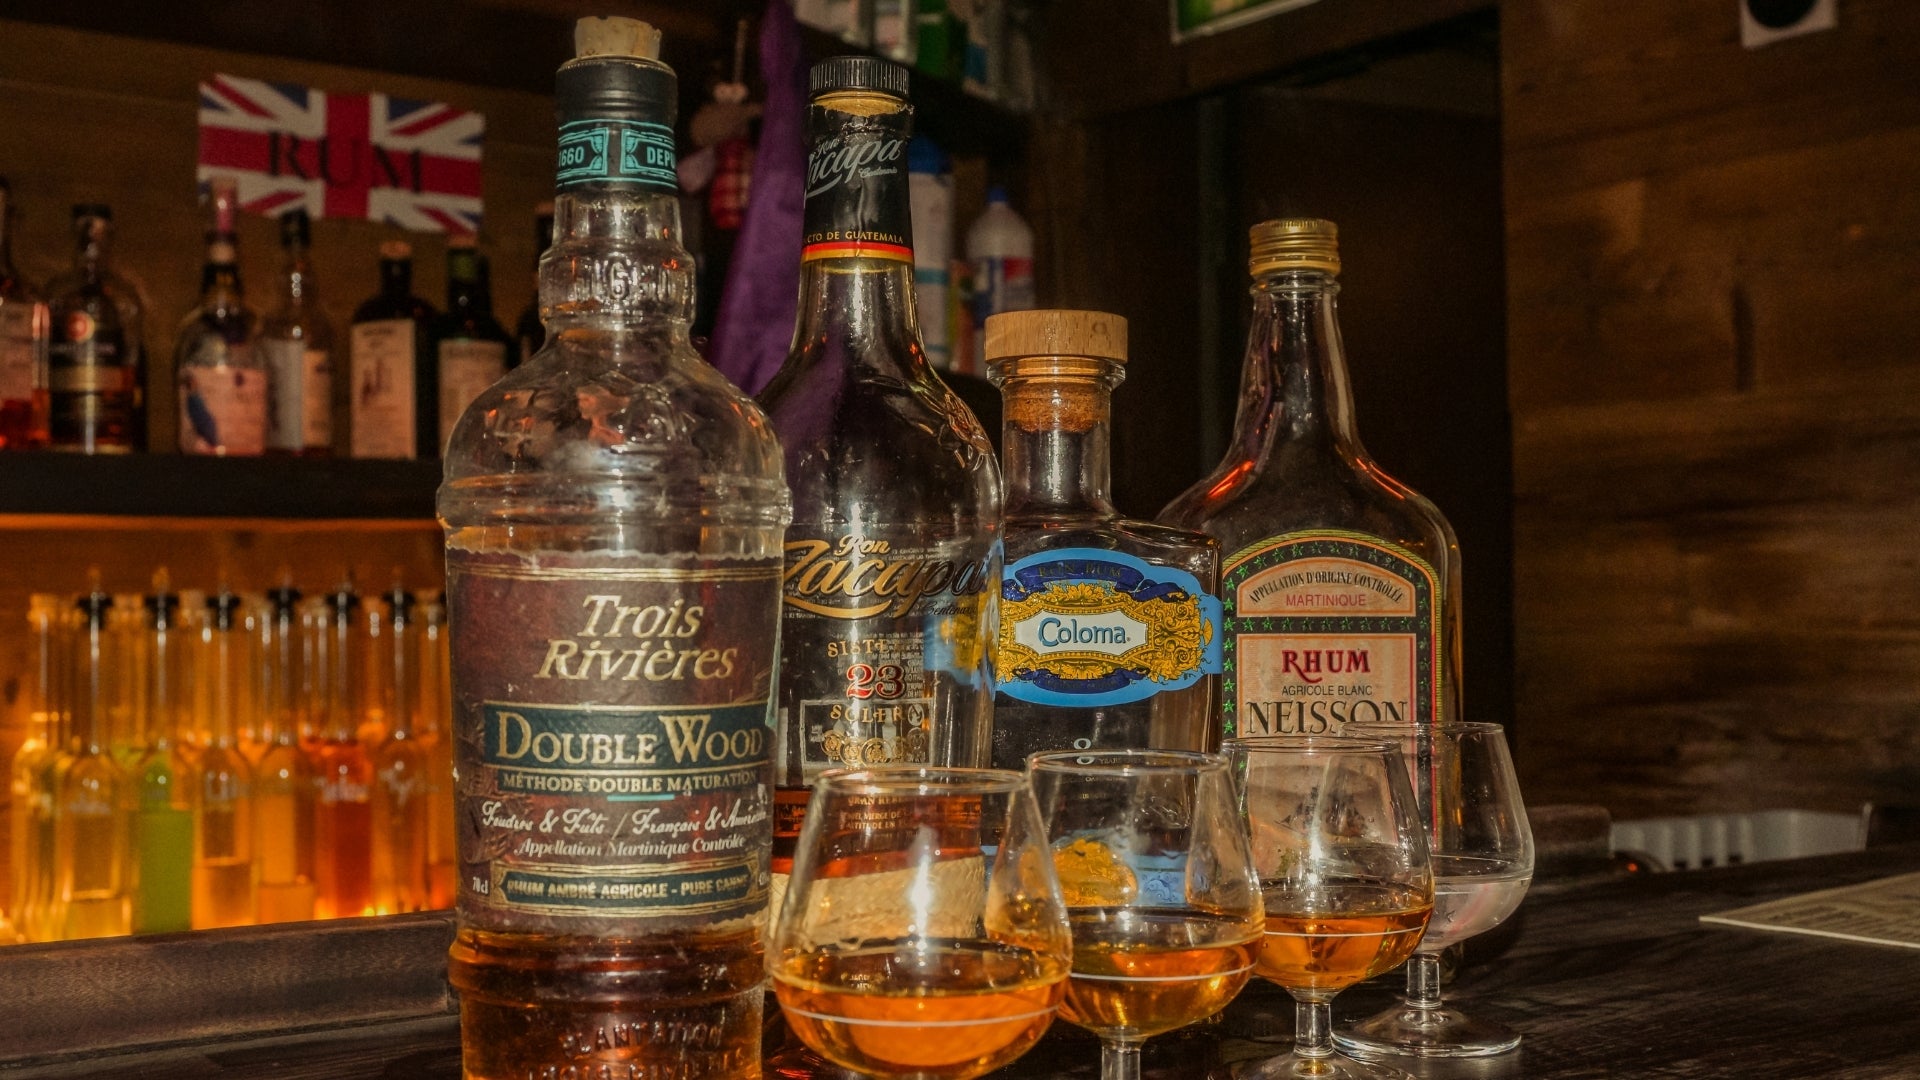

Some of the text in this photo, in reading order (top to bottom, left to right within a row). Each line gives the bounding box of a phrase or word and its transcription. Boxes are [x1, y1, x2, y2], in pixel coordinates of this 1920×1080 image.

[267, 131, 421, 193] RUM
[558, 146, 585, 167] 1660
[806, 139, 904, 190] acapa
[826, 231, 840, 240] DE
[845, 231, 904, 243] GUATEMALA
[834, 534, 891, 556] Ron
[1249, 572, 1304, 603] APPELLATION
[1306, 571, 1353, 584] D'ORIGINE
[1286, 594, 1367, 606] MARTINIQUE
[577, 595, 704, 638] Trois
[1038, 617, 1126, 647] Coloma
[533, 639, 738, 681] Rivières
[1282, 650, 1371, 683] RHUM
[846, 664, 907, 699] 23
[1282, 685, 1373, 696] AGRICOLE BLANC
[1246, 700, 1408, 734] NEISSON
[496, 711, 763, 765] DOUBLE WOOD
[503, 770, 757, 793] MÉTHODE DOUBLE MATURATION
[539, 809, 559, 833] &
[632, 808, 699, 838] Français
[704, 806, 722, 831] &
[513, 838, 602, 858] Appellation
[606, 839, 690, 858] Martinique
[547, 881, 597, 899] AMBRÉ
[601, 882, 669, 899] AGRICOLE
[680, 879, 714, 896] PURE
